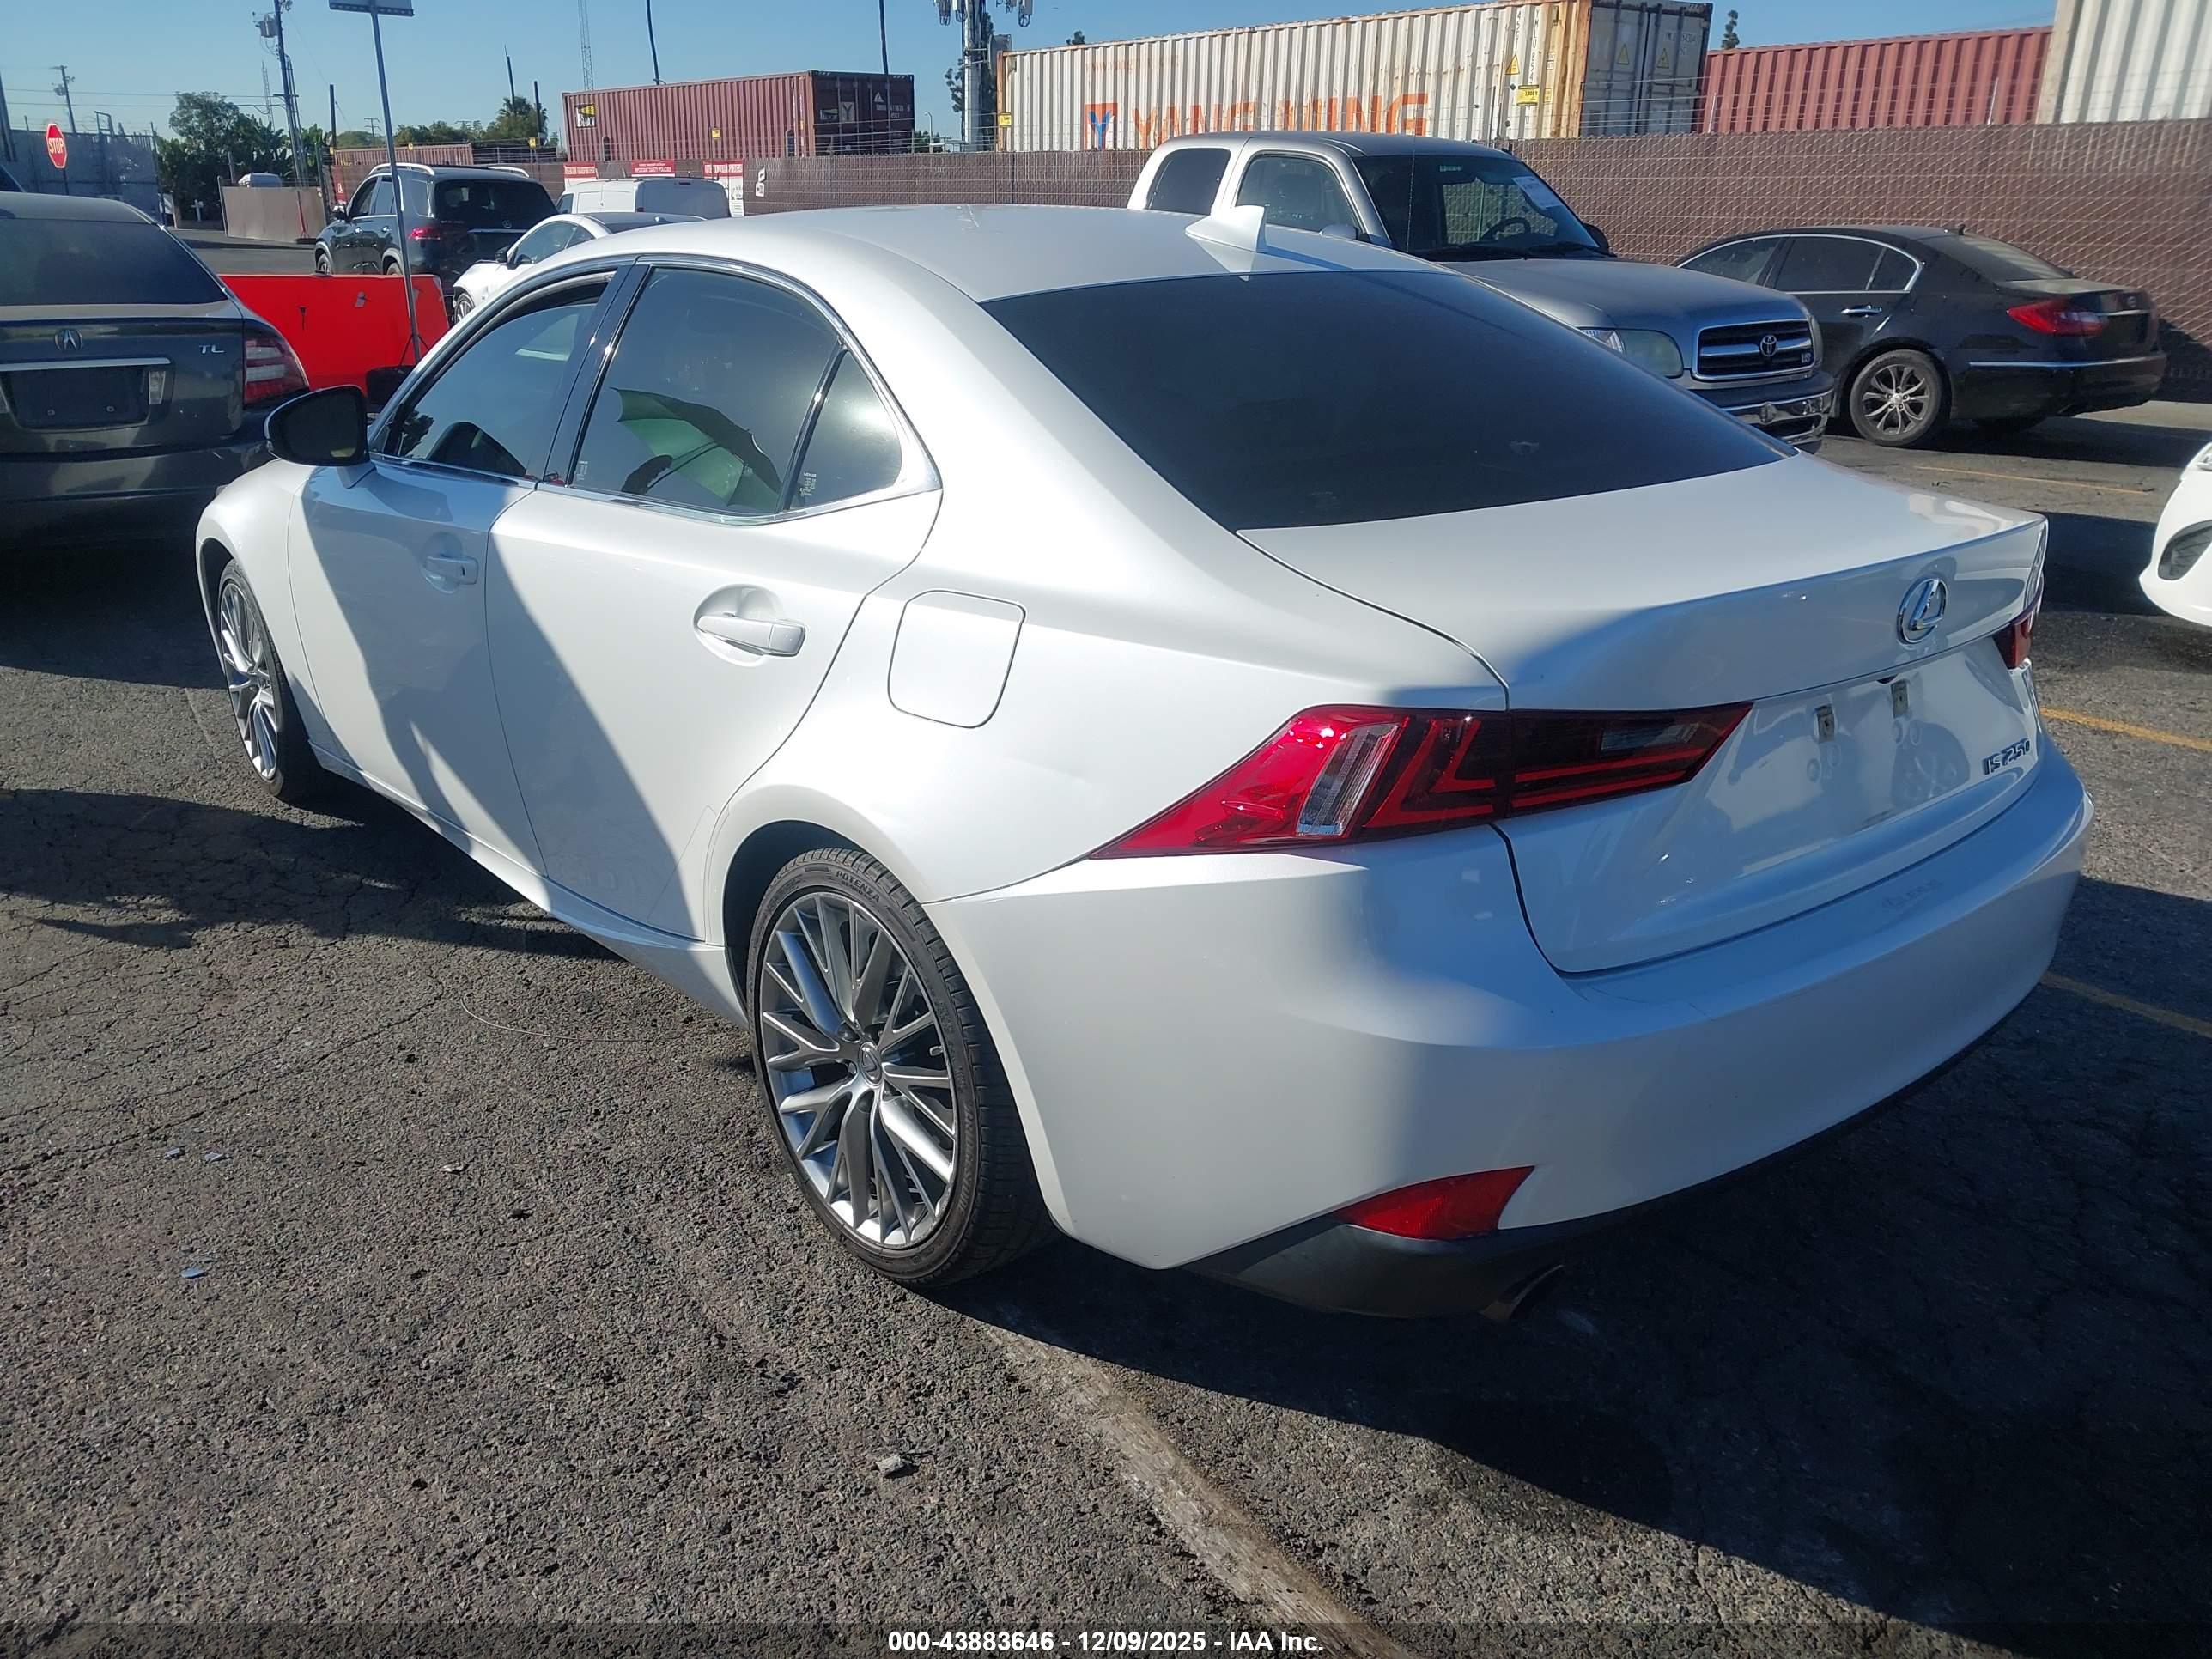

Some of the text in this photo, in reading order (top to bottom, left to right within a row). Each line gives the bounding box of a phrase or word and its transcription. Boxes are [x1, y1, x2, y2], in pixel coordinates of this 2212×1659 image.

[1132, 100, 1257, 150] YANG
[48, 137, 64, 154] STOP
[198, 344, 225, 354] TL
[1982, 738, 2031, 775] IS 250
[836, 871, 880, 903] POTENZA
